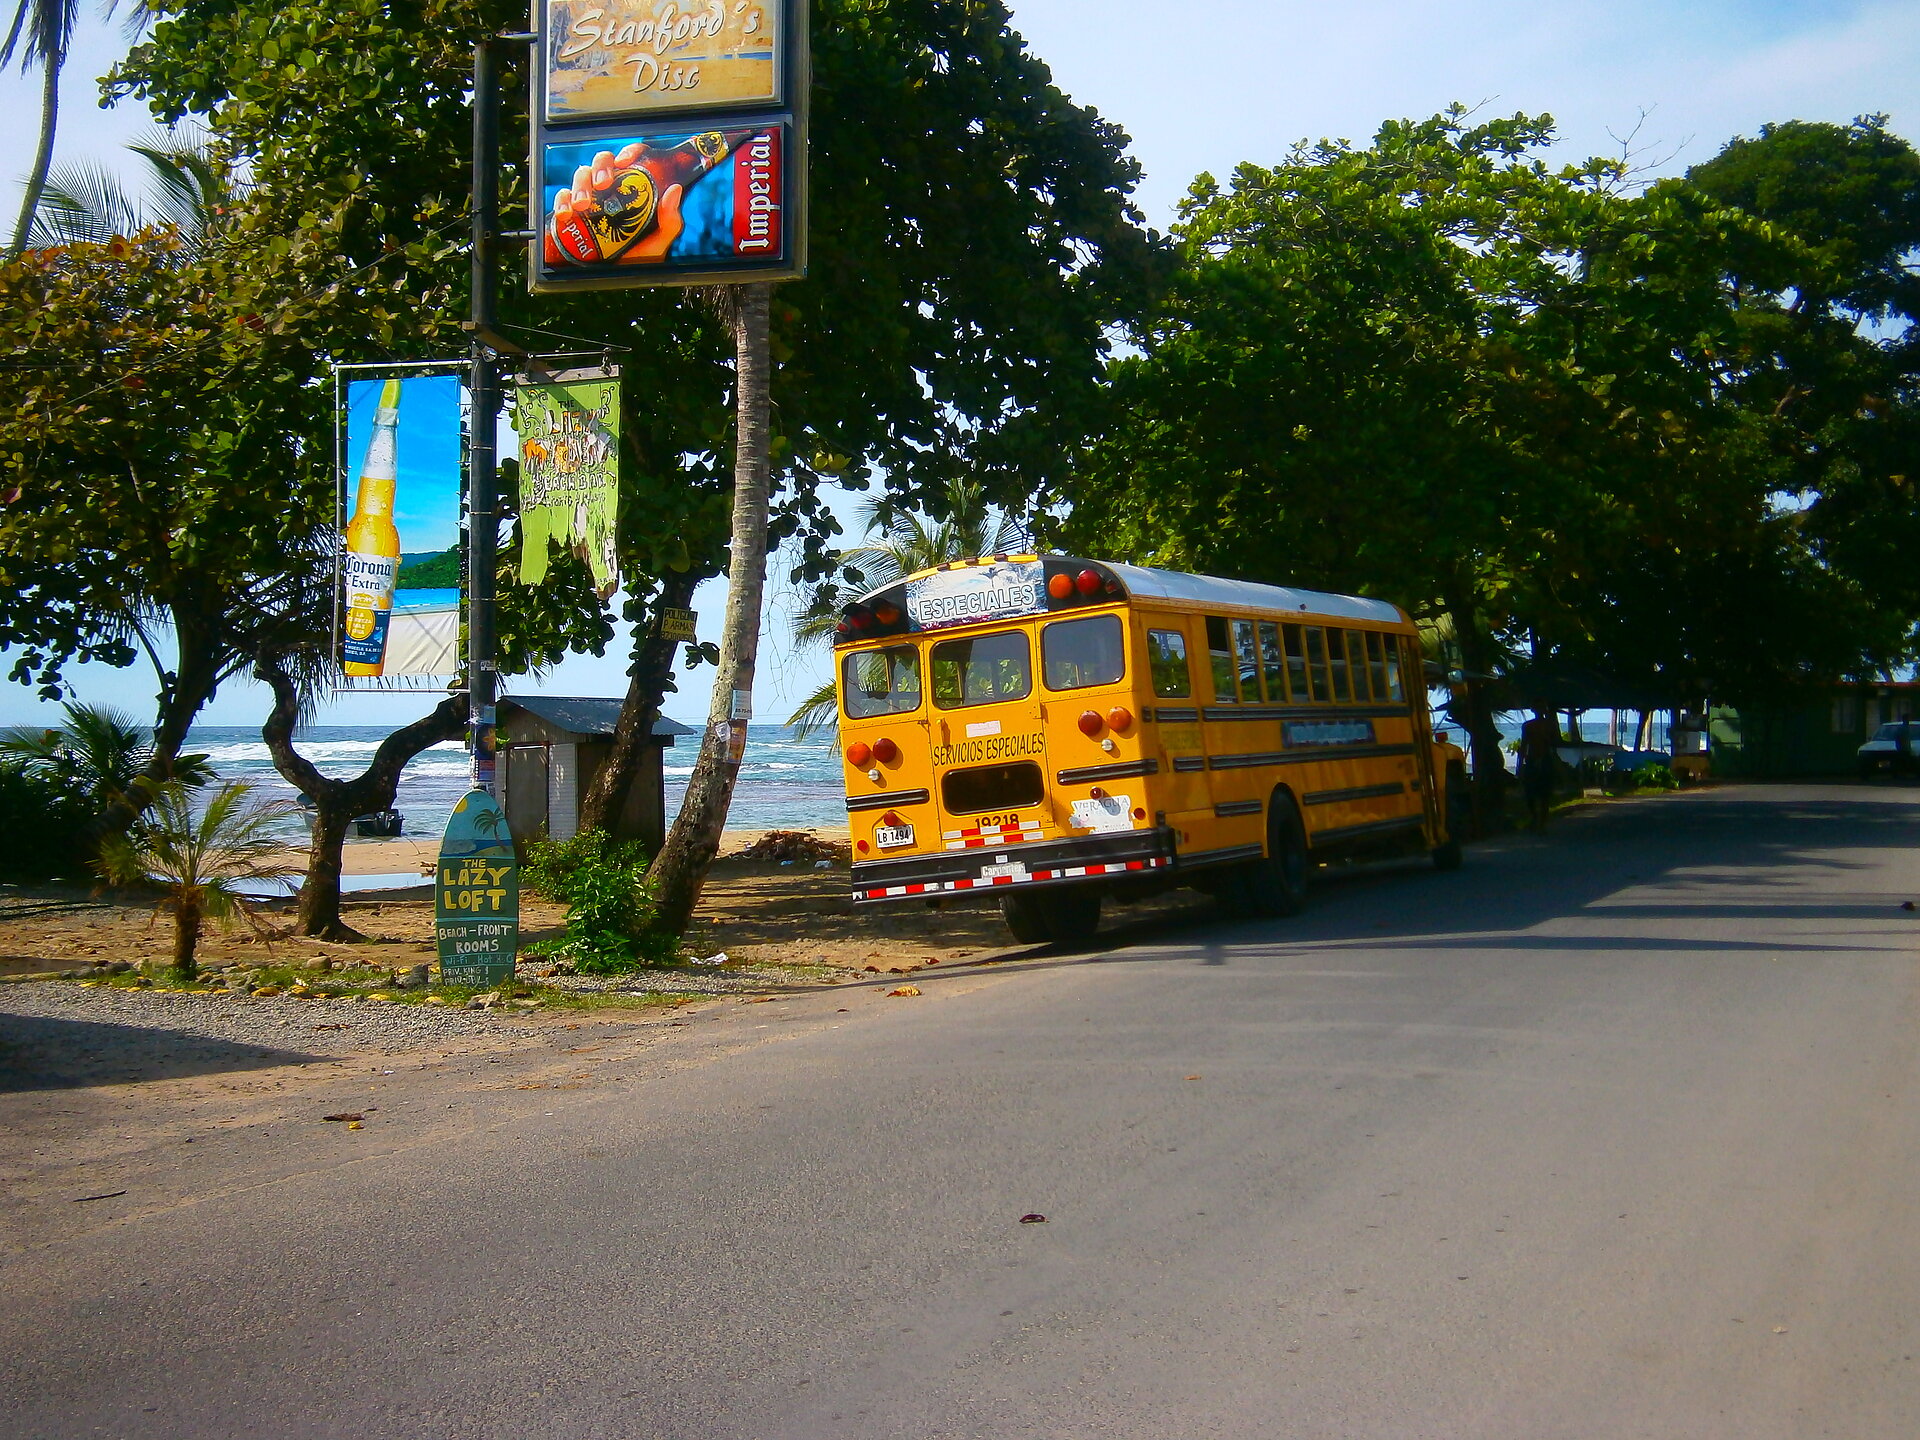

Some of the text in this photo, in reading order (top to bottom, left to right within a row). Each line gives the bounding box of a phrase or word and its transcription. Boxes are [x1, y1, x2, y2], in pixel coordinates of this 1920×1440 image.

[561, 0, 759, 57] Stanford's
[624, 53, 701, 93] Disc
[739, 134, 781, 252] Imperial
[561, 220, 594, 259] perial
[558, 400, 575, 408] THE
[345, 555, 391, 576] Corona
[351, 574, 380, 590] Extra
[919, 584, 1035, 620] ESPECIALES
[933, 732, 1044, 767] SERVICIOS ESPECIALES
[975, 813, 1020, 829] 19218
[877, 832, 888, 844] LB
[890, 829, 910, 842] 1494
[462, 858, 487, 868] THE
[443, 866, 512, 886] LAZY
[444, 889, 507, 912] LOFT
[455, 938, 500, 954] ROOMS
